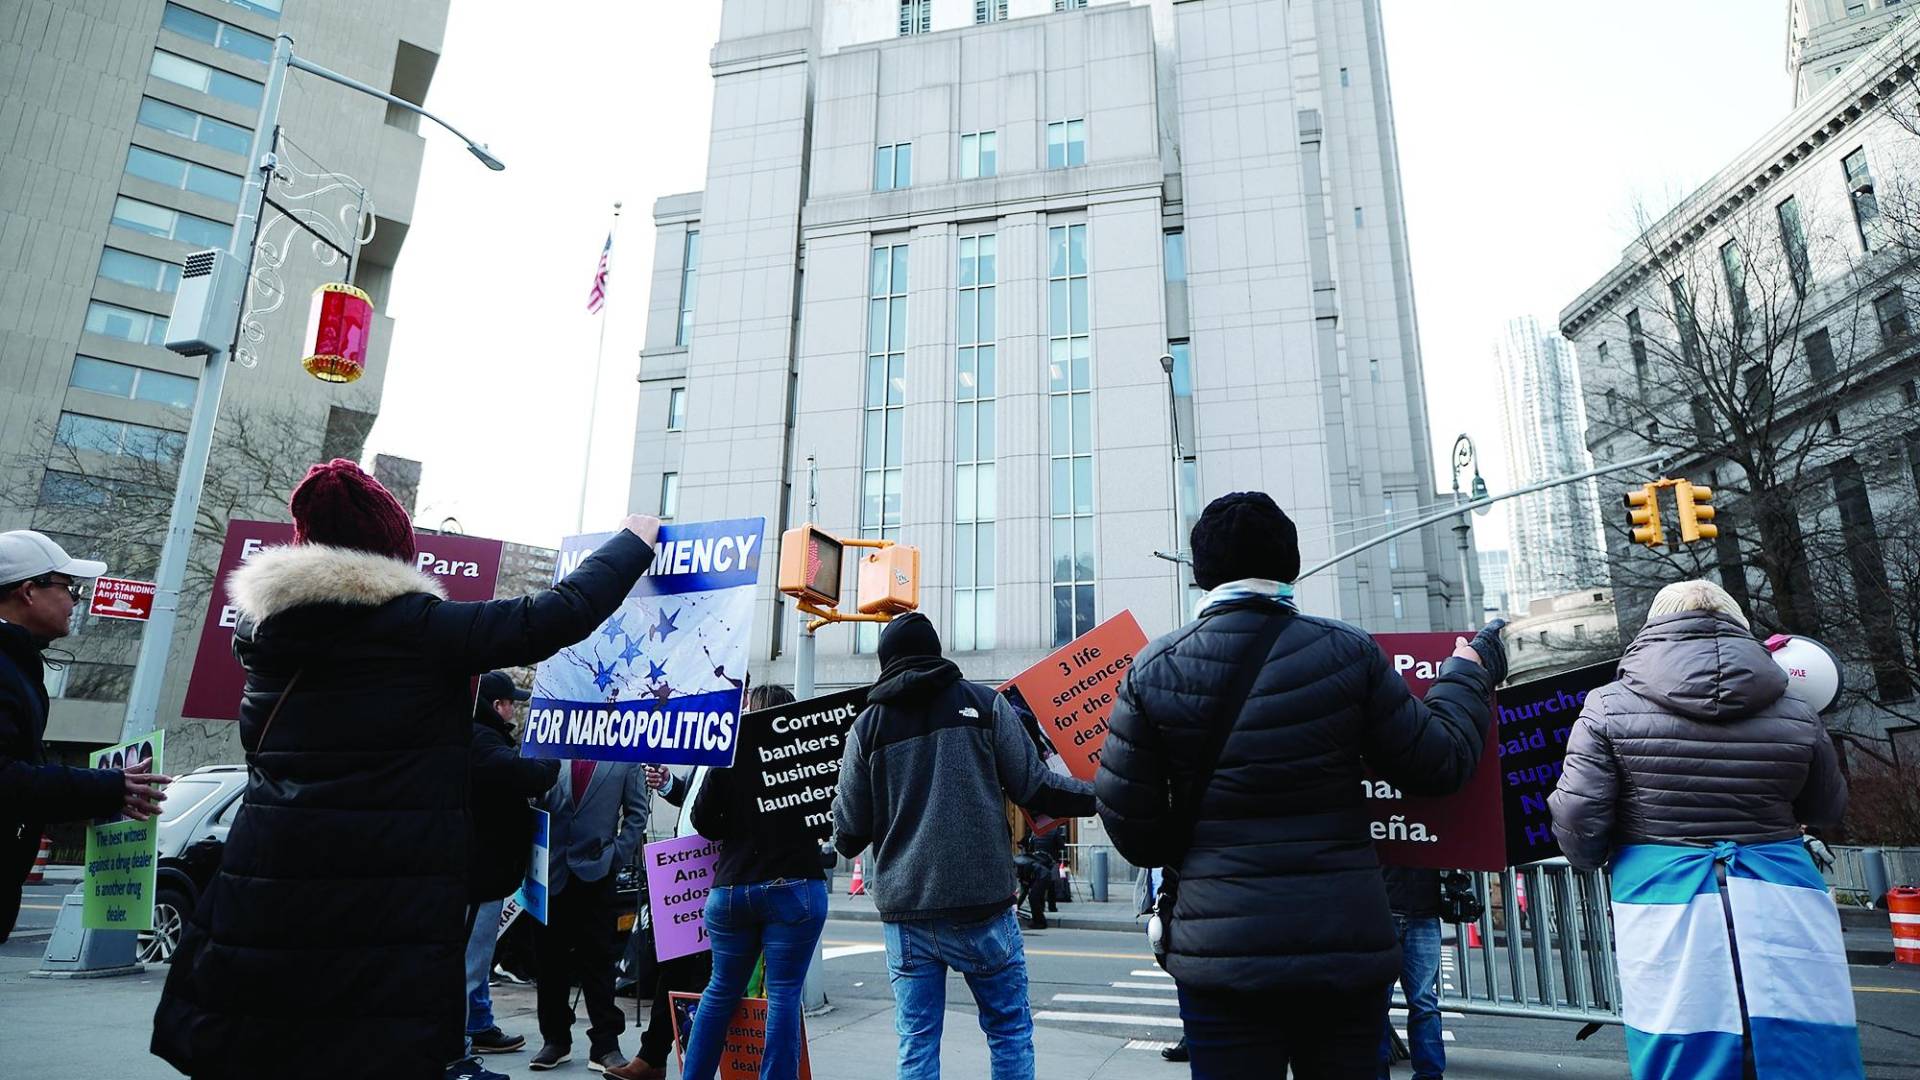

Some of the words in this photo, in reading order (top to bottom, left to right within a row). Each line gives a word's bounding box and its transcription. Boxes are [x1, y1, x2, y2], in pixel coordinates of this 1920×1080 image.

[417, 552, 480, 578] Para
[648, 534, 757, 577] MENCY
[98, 590, 134, 600] Anytime
[99, 581, 112, 589] NO
[114, 583, 156, 595] STANDING
[1058, 662, 1072, 677] 3
[1072, 647, 1102, 668] life
[1052, 653, 1134, 708] sentences
[772, 702, 857, 734] Corrupt
[1054, 710, 1079, 731] for
[1082, 692, 1113, 714] the
[525, 709, 563, 744] FOR
[565, 709, 735, 751] NARCOPOLITICS
[1073, 717, 1110, 746] deal
[758, 734, 840, 763] bankers
[762, 757, 844, 787] business
[96, 831, 107, 848] The
[109, 829, 122, 846] best
[124, 826, 147, 842] witness
[1370, 815, 1438, 843] eña.
[89, 856, 110, 877] against
[116, 854, 130, 874] drug
[132, 850, 152, 869] dealer
[674, 867, 708, 884] Ana
[101, 880, 125, 896] another
[126, 880, 141, 901] drug
[664, 887, 709, 906] todos
[106, 905, 127, 922] dealer.
[673, 907, 705, 924] test
[741, 1008, 750, 1019] 3
[753, 1009, 767, 1021] lif
[731, 1059, 760, 1073] deal
